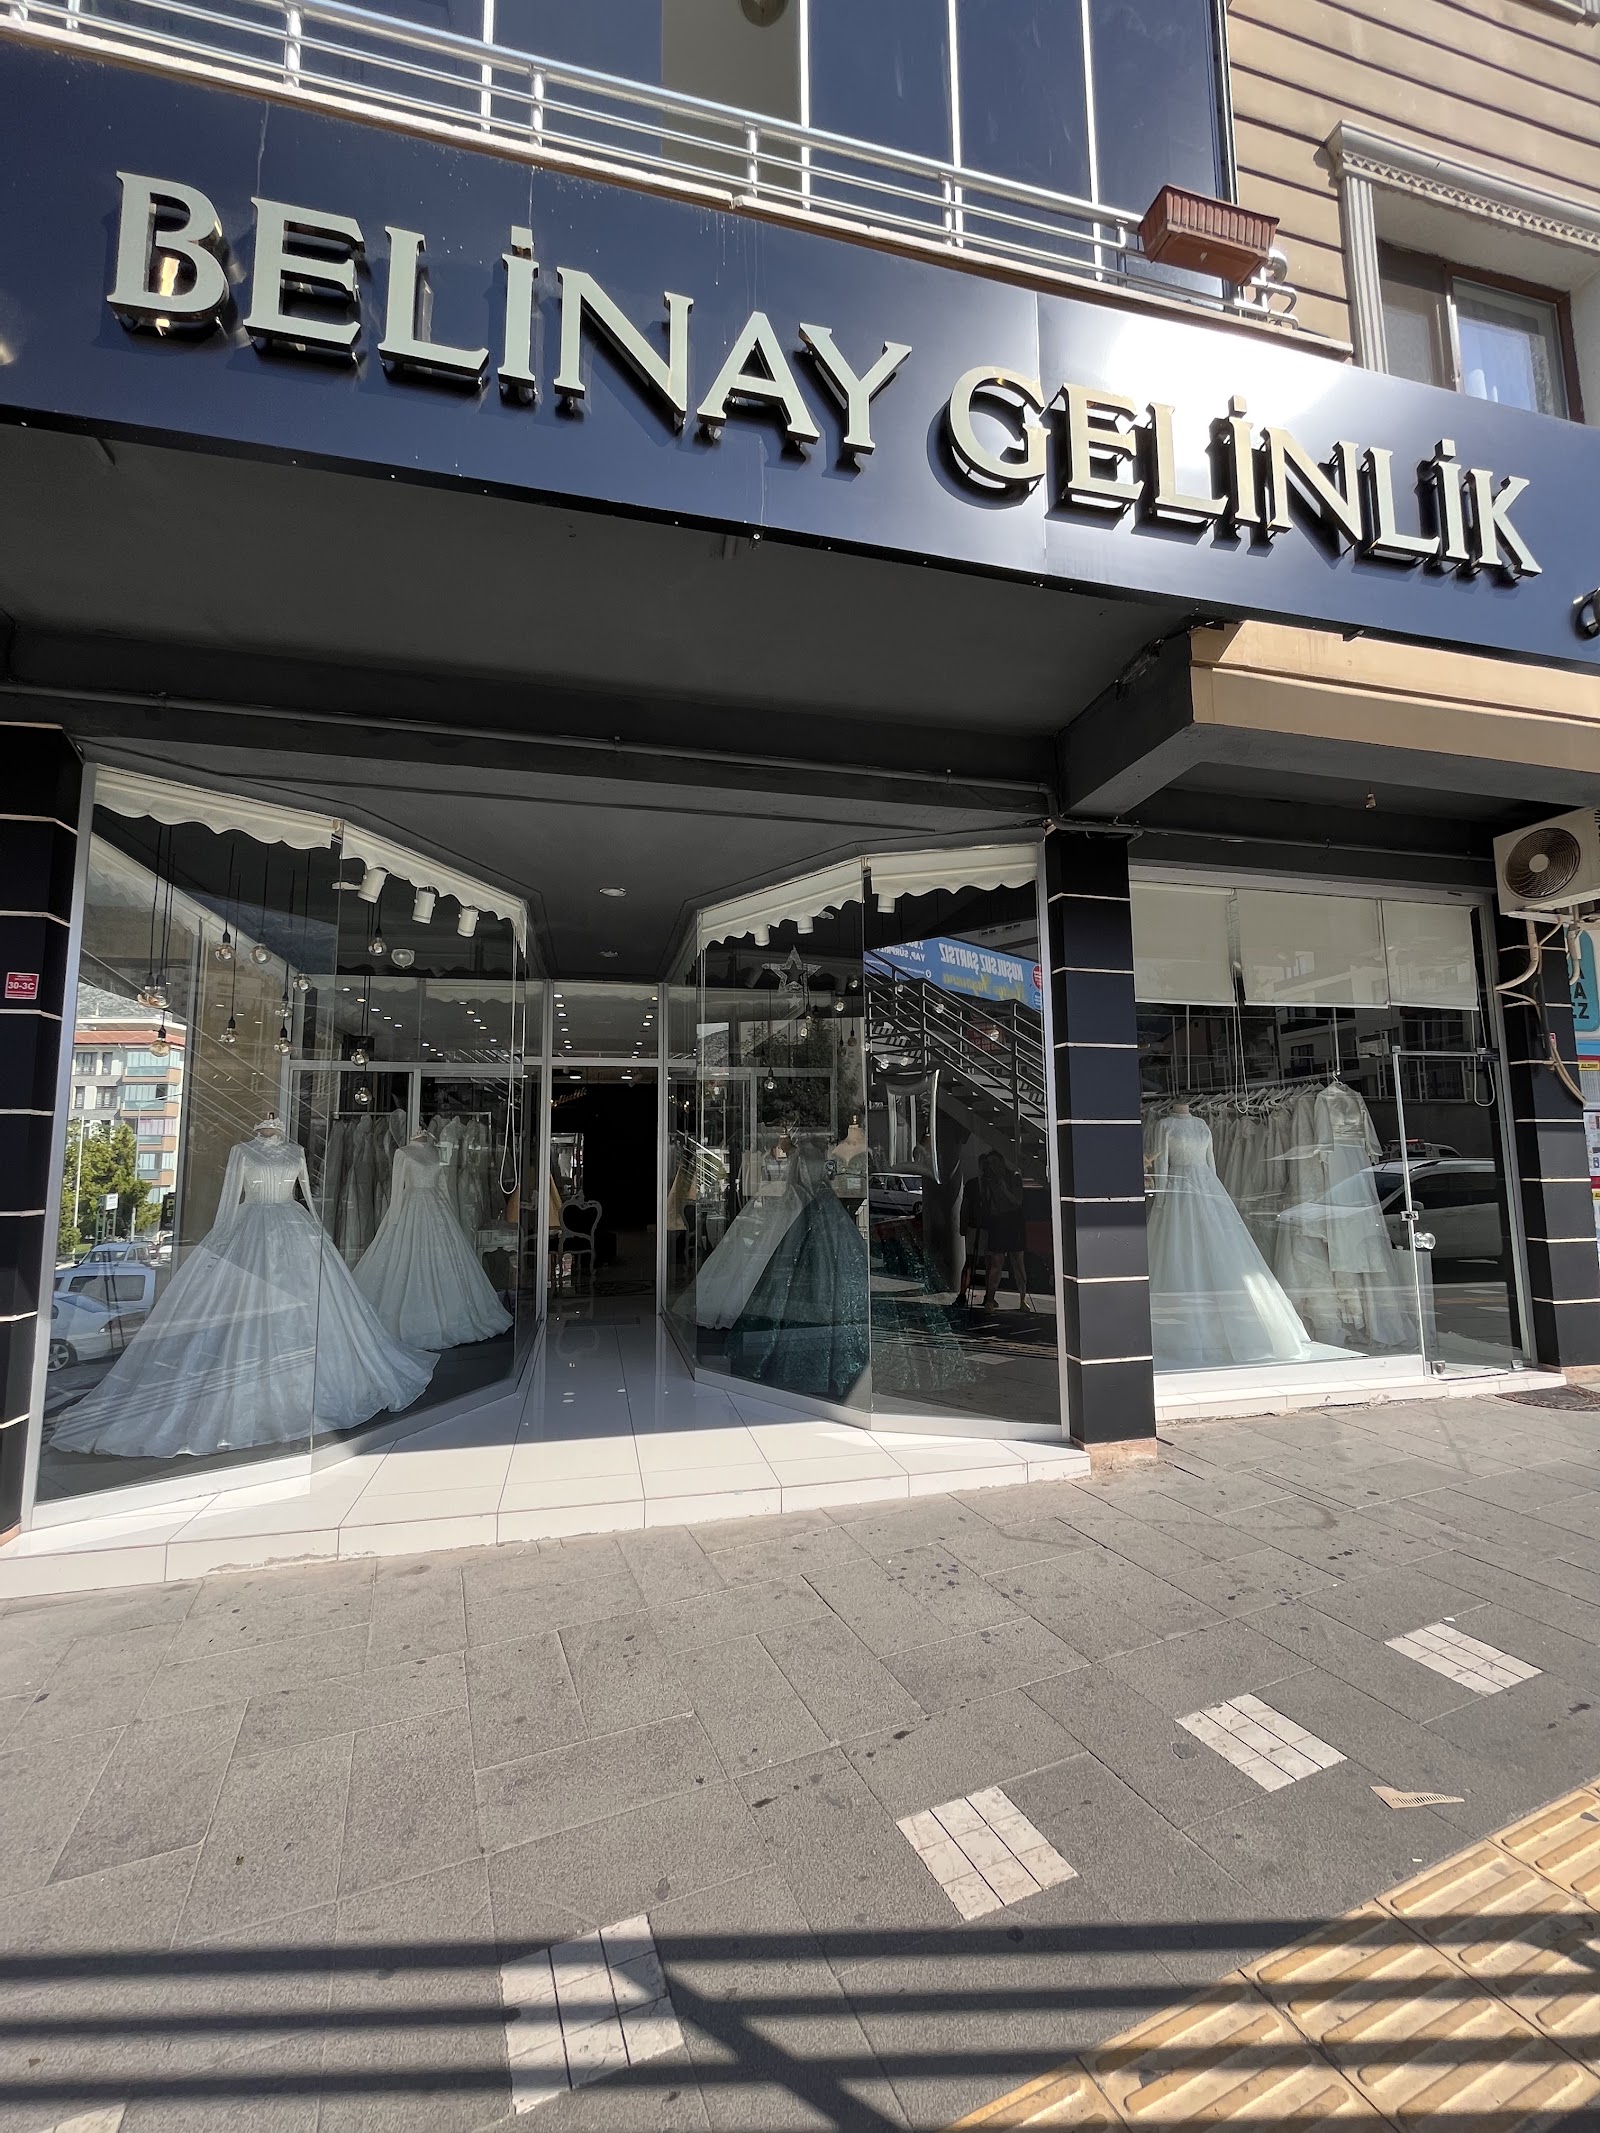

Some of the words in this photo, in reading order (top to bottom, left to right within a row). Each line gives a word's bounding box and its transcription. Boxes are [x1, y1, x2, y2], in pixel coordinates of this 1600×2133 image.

[107, 171, 912, 453] BELİNAY
[949, 366, 1543, 576] GELİNLİK
[8, 981, 35, 990] 30-3C
